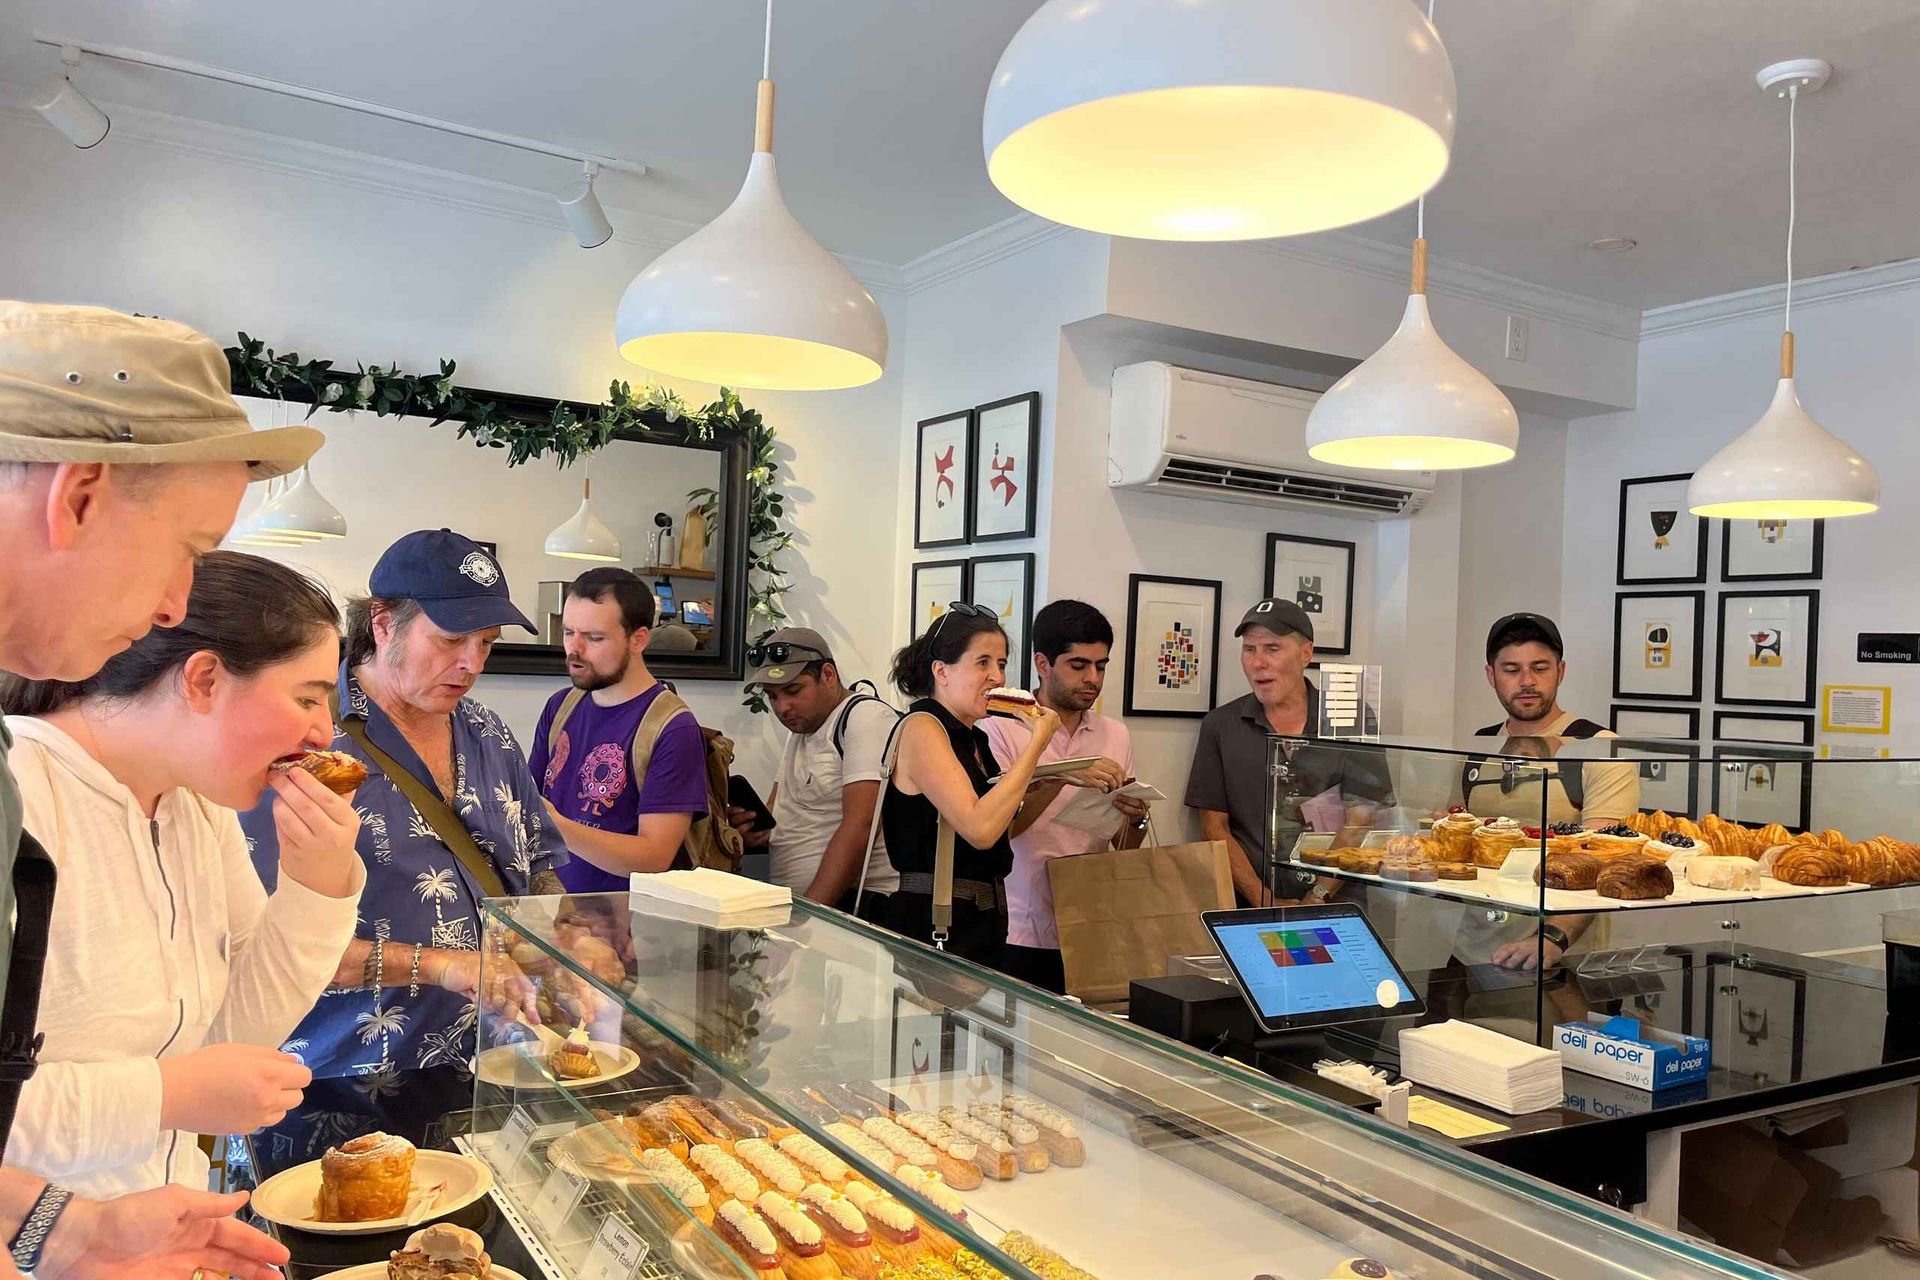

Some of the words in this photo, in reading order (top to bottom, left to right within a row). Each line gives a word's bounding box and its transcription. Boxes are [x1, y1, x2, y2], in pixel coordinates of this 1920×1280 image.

[1861, 650, 1873, 659] No
[1875, 651, 1912, 662] Smoking
[1561, 1031, 1587, 1049] deli
[1594, 1041, 1643, 1063] paper
[1665, 1060, 1679, 1074] deli
[1681, 1057, 1703, 1073] paper
[614, 1229, 630, 1248] Lemon
